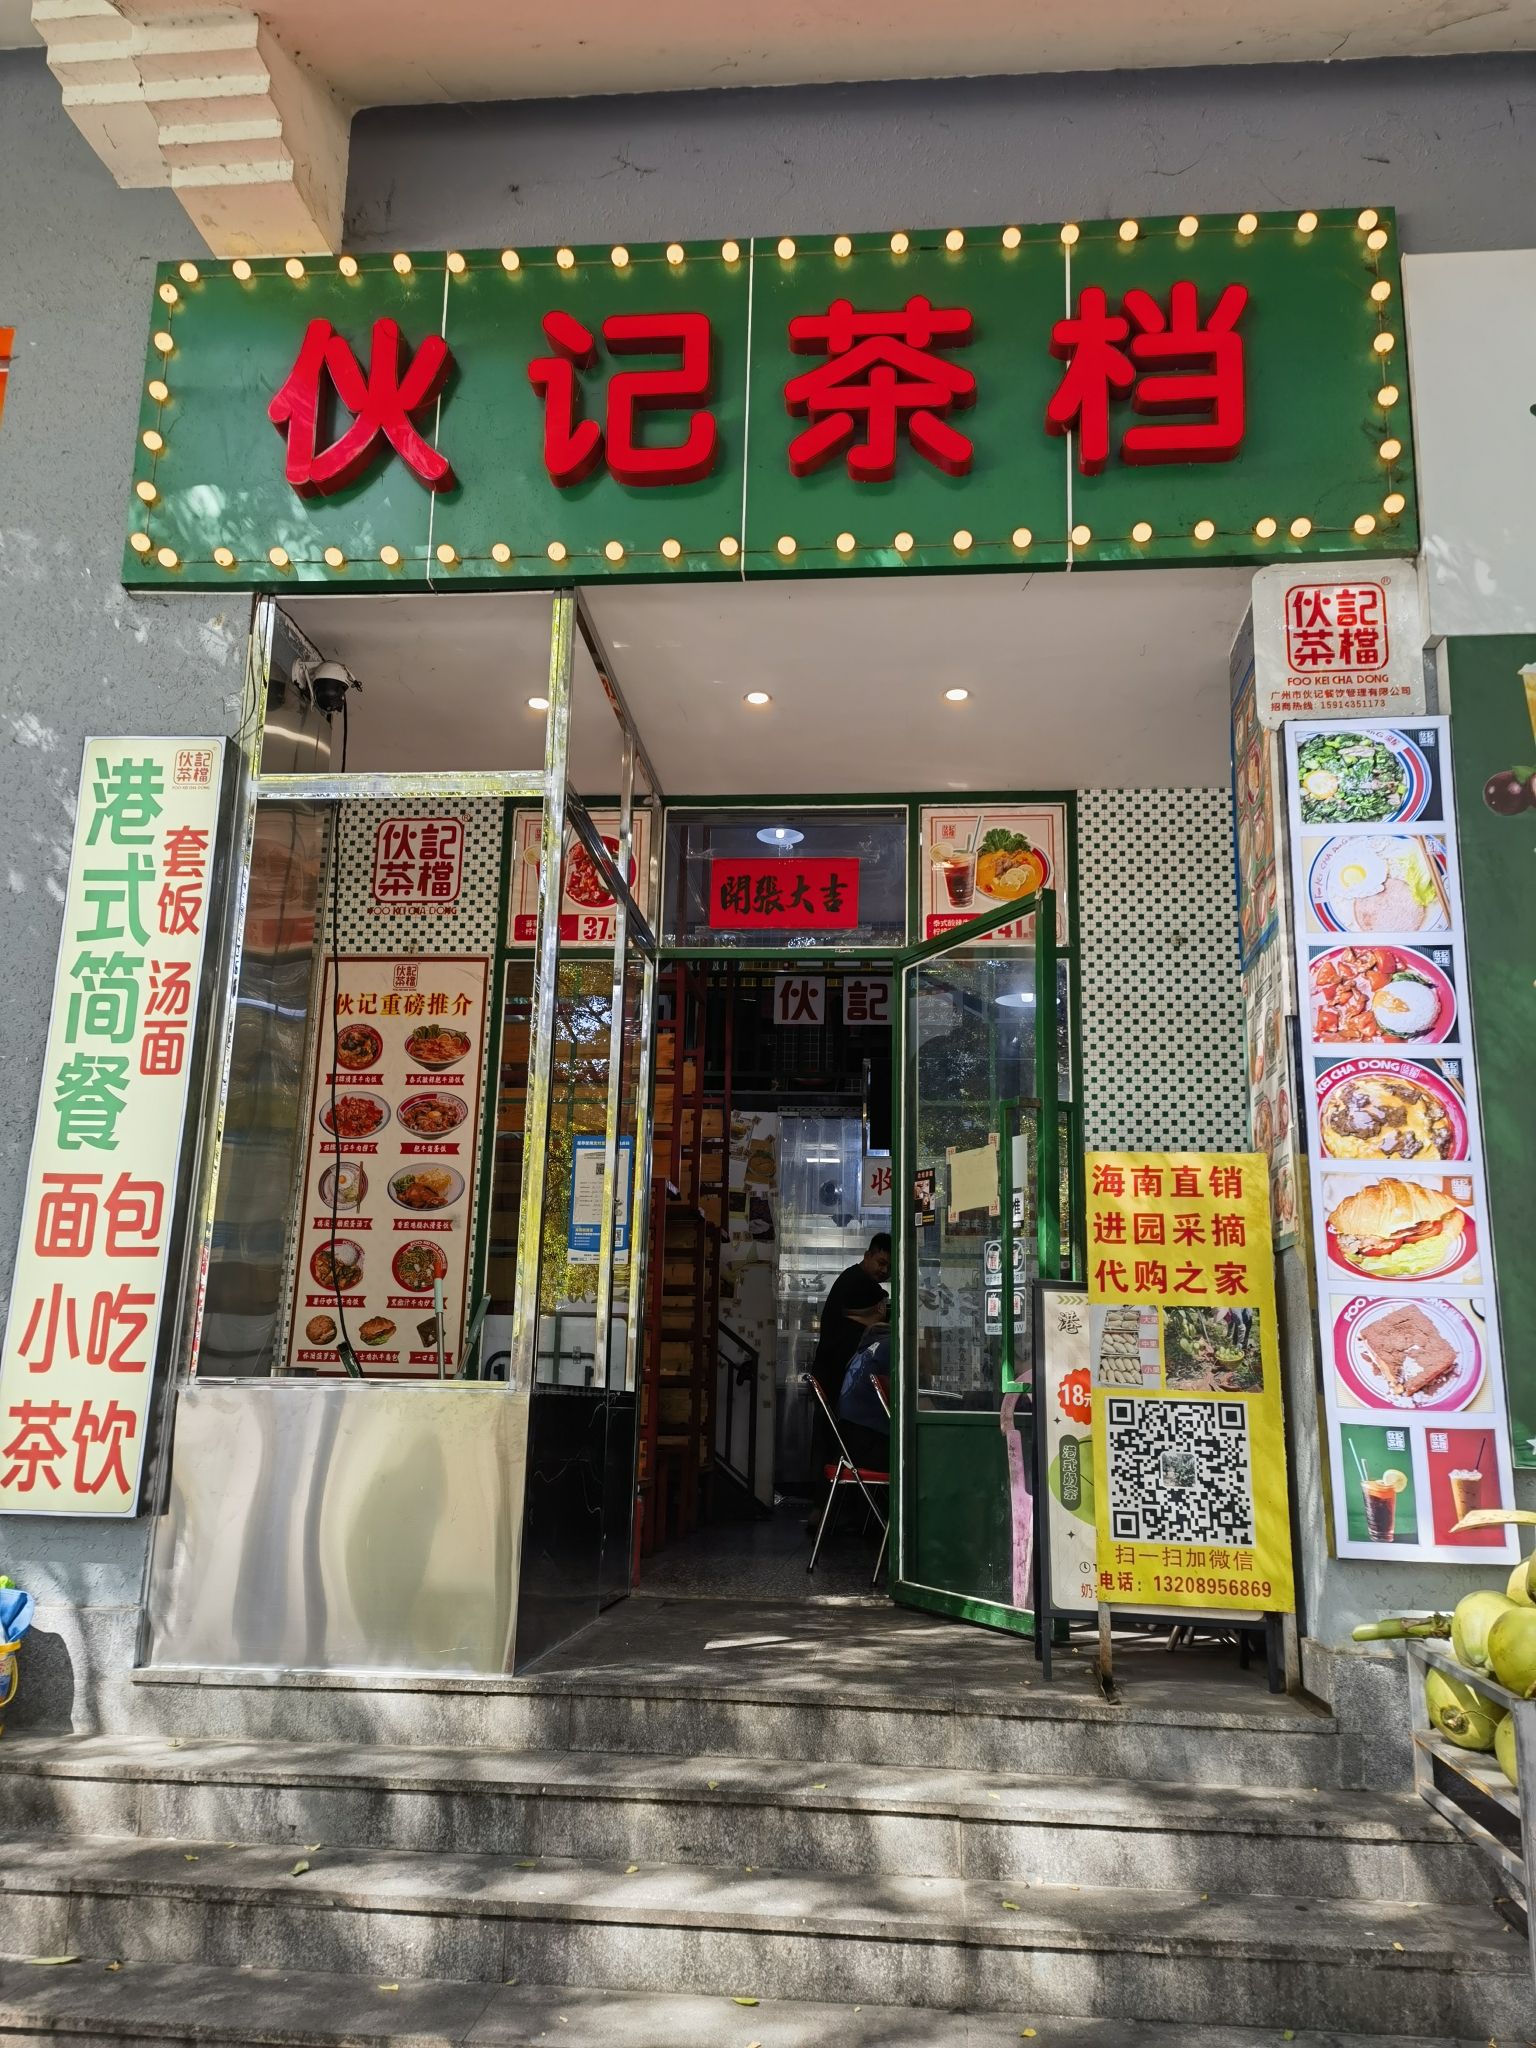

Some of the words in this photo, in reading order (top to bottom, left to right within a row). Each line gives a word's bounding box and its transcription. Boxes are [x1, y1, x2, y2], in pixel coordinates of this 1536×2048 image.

[268, 281, 1248, 498] 伙记茶档
[1292, 588, 1379, 628] 伙記
[1293, 628, 1380, 666] 茶檔
[1271, 686, 1411, 700] 广州市伙记餐饮管理有限公司
[1287, 677, 1312, 686] FOO
[1315, 676, 1330, 686] KEI
[1332, 675, 1354, 685] CHA
[1357, 674, 1389, 684] DONG
[1320, 699, 1386, 710] 15914351173
[176, 767, 209, 783] 茶檔
[178, 751, 211, 767] 伙記
[382, 823, 457, 859] 伙記
[157, 825, 209, 936] 套饭
[378, 861, 454, 897] 茶檔
[720, 873, 848, 915] 開張大吉
[584, 917, 617, 940] 37.
[53, 757, 165, 1151] 港式简餐
[139, 960, 191, 1076] 汤面
[336, 993, 473, 1016] 伙记重磅推介
[1330, 1064, 1355, 1080] CHA
[1358, 1060, 1400, 1072] DONG
[1091, 1163, 1243, 1199] 海南直销
[34, 1172, 165, 1257] 面包
[1093, 1211, 1246, 1247] 进园采摘
[1094, 1259, 1249, 1296] 代购之家
[17, 1283, 155, 1373] 小吃
[1057, 1311, 1083, 1334] 港
[0, 1399, 137, 1495] 茶饮
[1062, 1445, 1077, 1501] 港式奶茶
[1115, 1544, 1254, 1572] 扫一扫加微信
[1153, 1575, 1272, 1598] 13208956869
